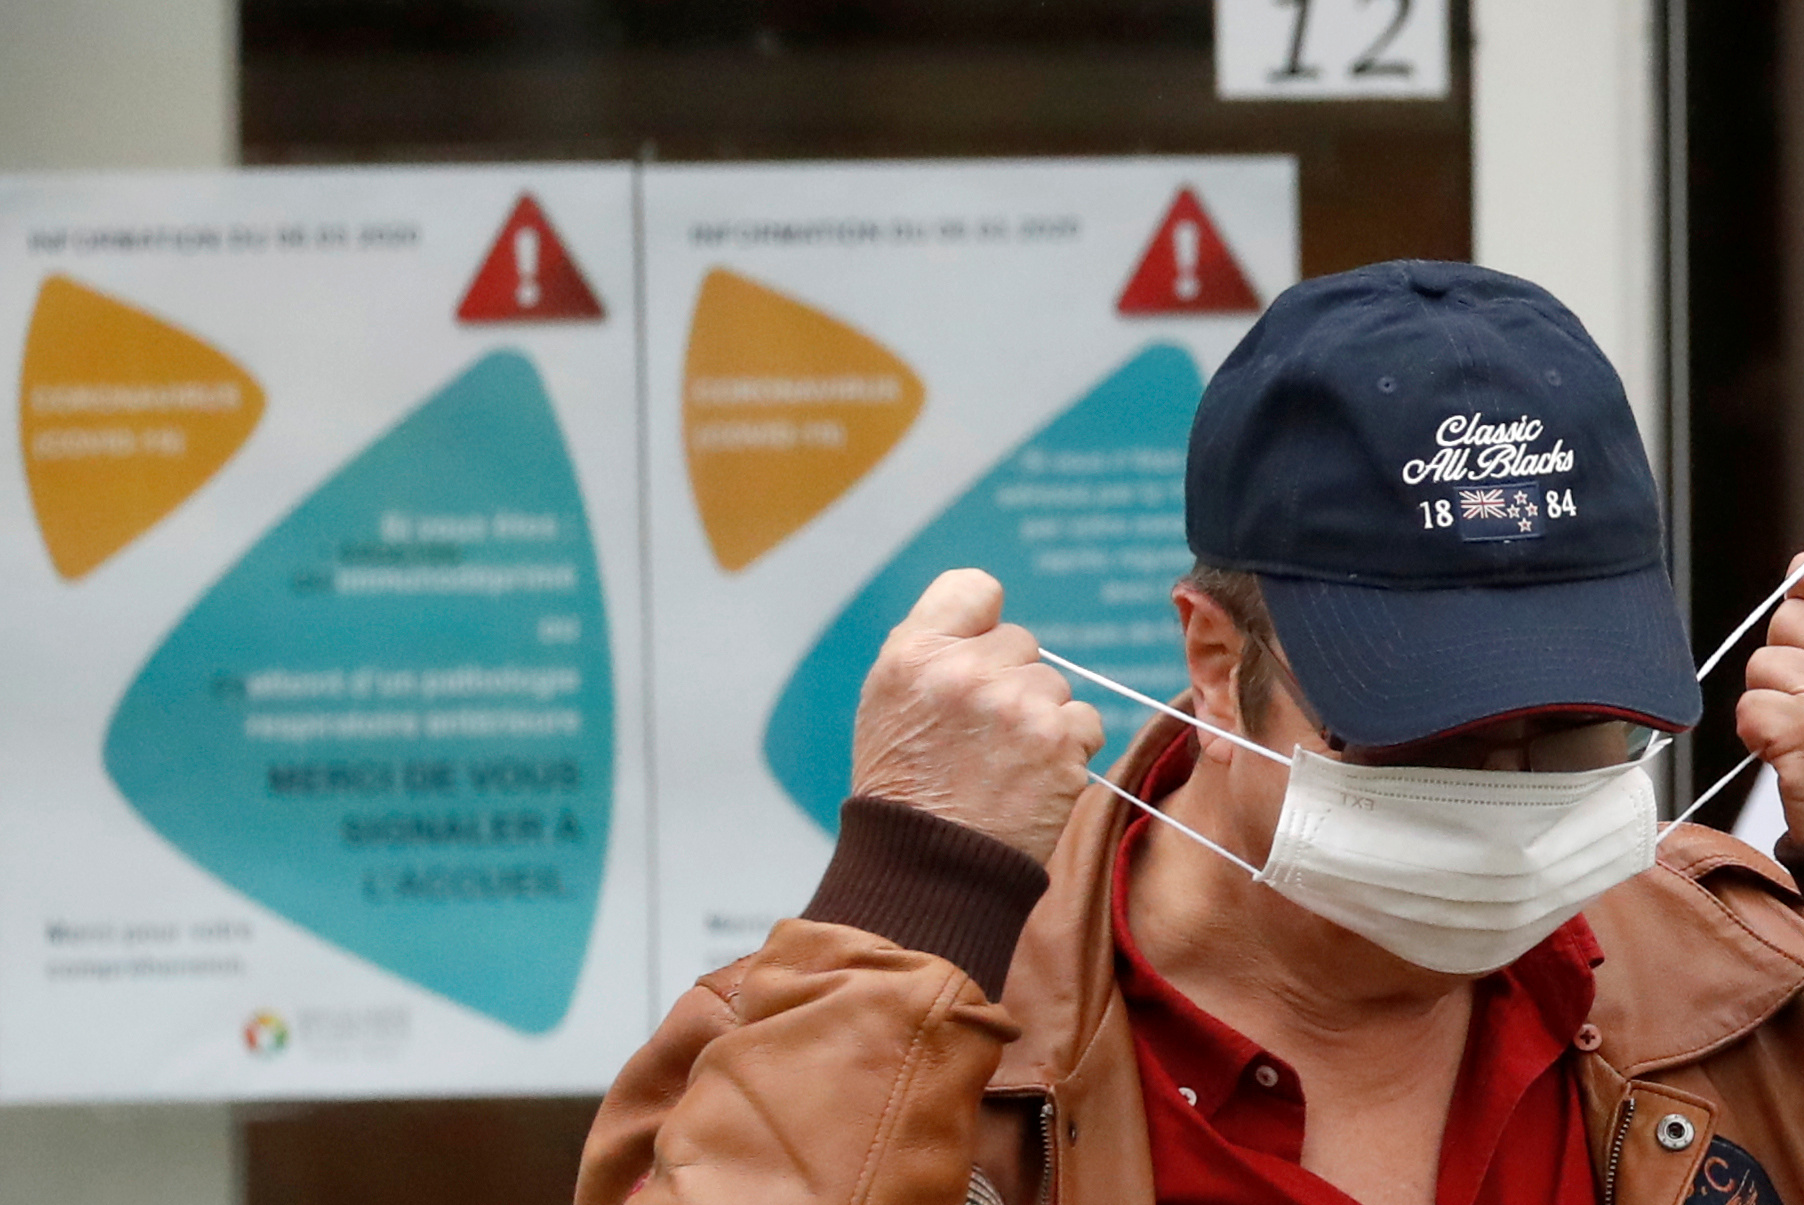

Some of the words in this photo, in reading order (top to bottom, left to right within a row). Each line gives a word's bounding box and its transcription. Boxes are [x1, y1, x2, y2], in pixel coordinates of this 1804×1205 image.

[1264, 0, 1414, 83] 12
[1435, 412, 1543, 447] Classic
[1402, 447, 1468, 484] All
[1468, 439, 1574, 480] Blacks
[1418, 499, 1454, 530] 18
[1545, 488, 1577, 519] 84
[267, 762, 396, 797] MERCI
[403, 760, 456, 794] DE
[466, 757, 580, 792] VOUS
